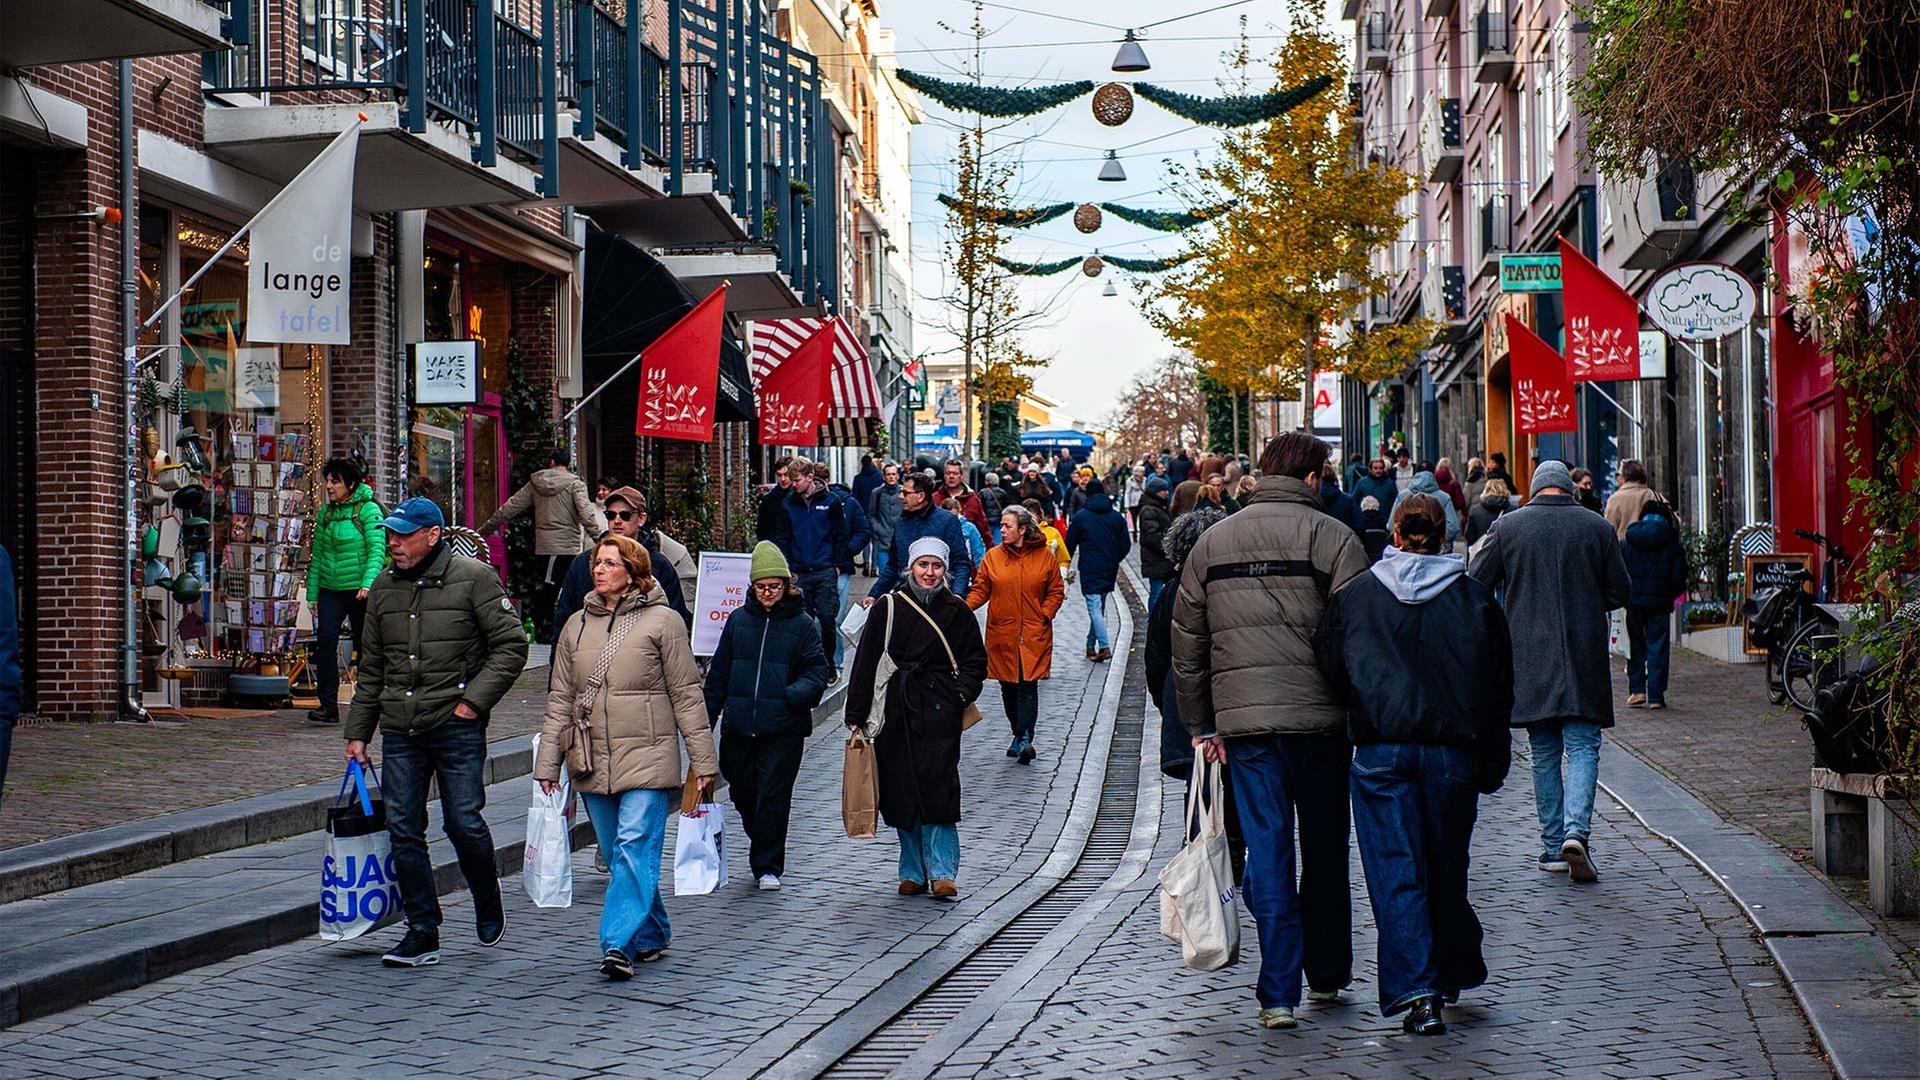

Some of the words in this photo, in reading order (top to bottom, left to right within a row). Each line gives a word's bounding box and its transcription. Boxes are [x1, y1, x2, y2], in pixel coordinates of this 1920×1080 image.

[313, 234, 341, 262] de
[264, 261, 341, 299] lange
[1504, 263, 1561, 281] TATTOO
[280, 304, 340, 333] tafel
[1571, 315, 1591, 376] MAKE
[1591, 327, 1622, 346] MY
[426, 355, 466, 368] MAKE
[1592, 345, 1633, 365] DAY
[643, 367, 667, 430] MAKE
[665, 383, 698, 404] MY
[909, 388, 922, 402] N
[1535, 389, 1560, 404] MY
[664, 402, 707, 424] DAY
[780, 404, 805, 419] MY
[1518, 379, 1536, 430] MAKE
[1536, 404, 1570, 420] DAY
[764, 392, 780, 440] MAKE
[780, 418, 812, 433] DAY
[725, 587, 742, 595] WE
